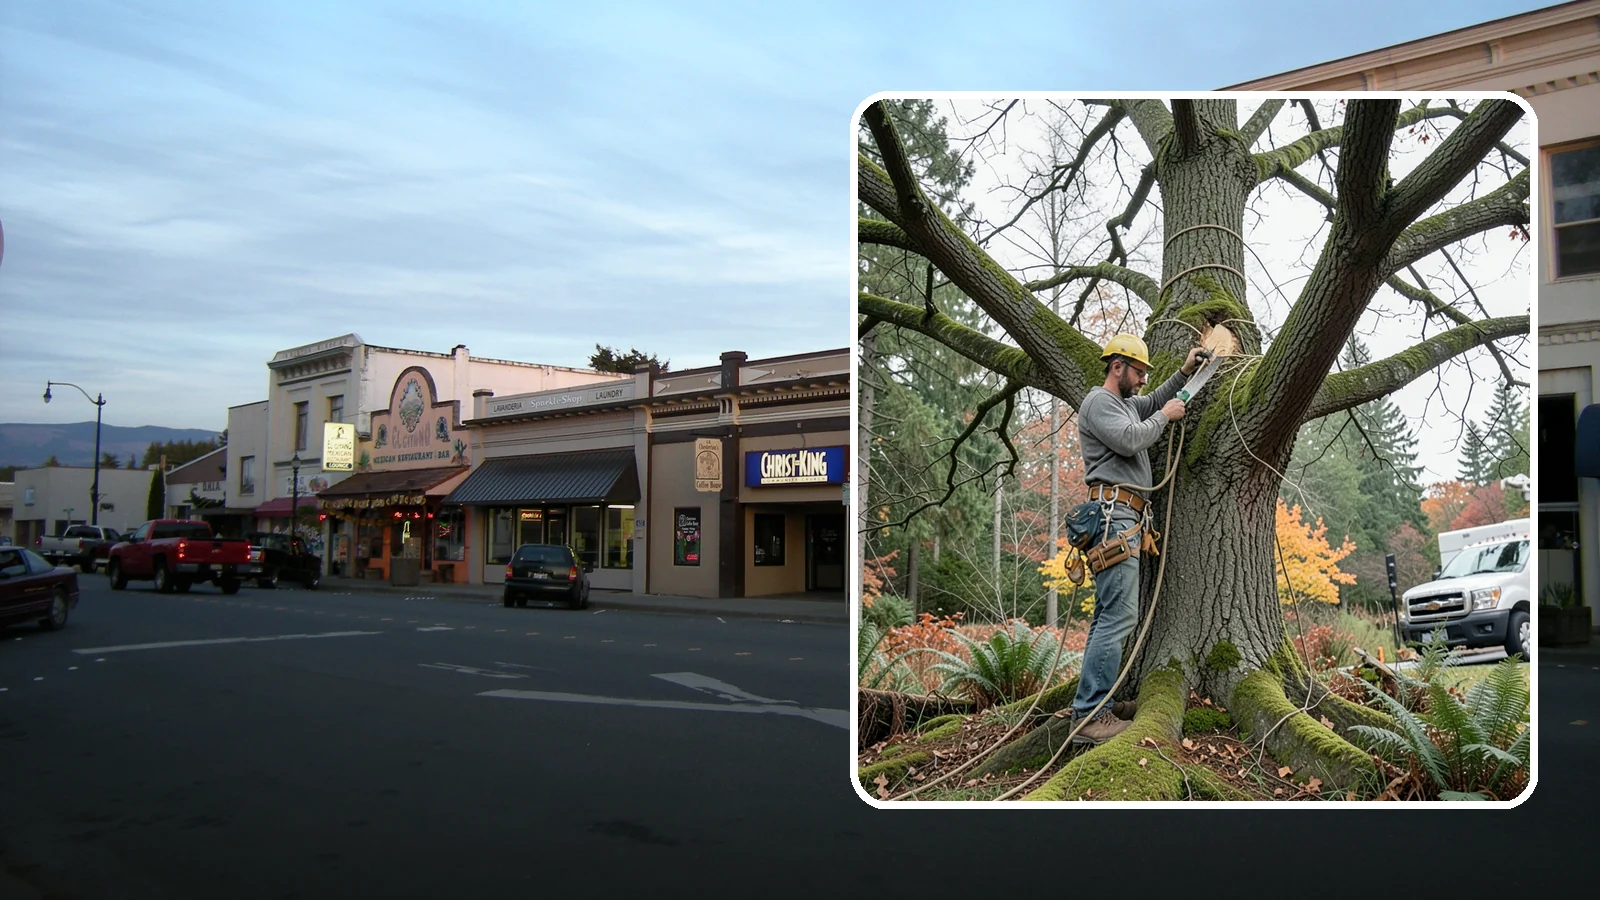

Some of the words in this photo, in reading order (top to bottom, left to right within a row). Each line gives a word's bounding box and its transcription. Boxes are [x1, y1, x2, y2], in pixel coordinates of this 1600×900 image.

[531, 398, 561, 409] Sparkle
[562, 394, 582, 406] Shop
[596, 389, 623, 400] LAUNDRY
[494, 402, 522, 412] LAVANDERIA
[373, 455, 396, 464] MEXICAN
[397, 451, 433, 462] RESTAURANT
[438, 450, 450, 459] BAR
[761, 452, 797, 478] CHRIST
[799, 450, 827, 476] KING
